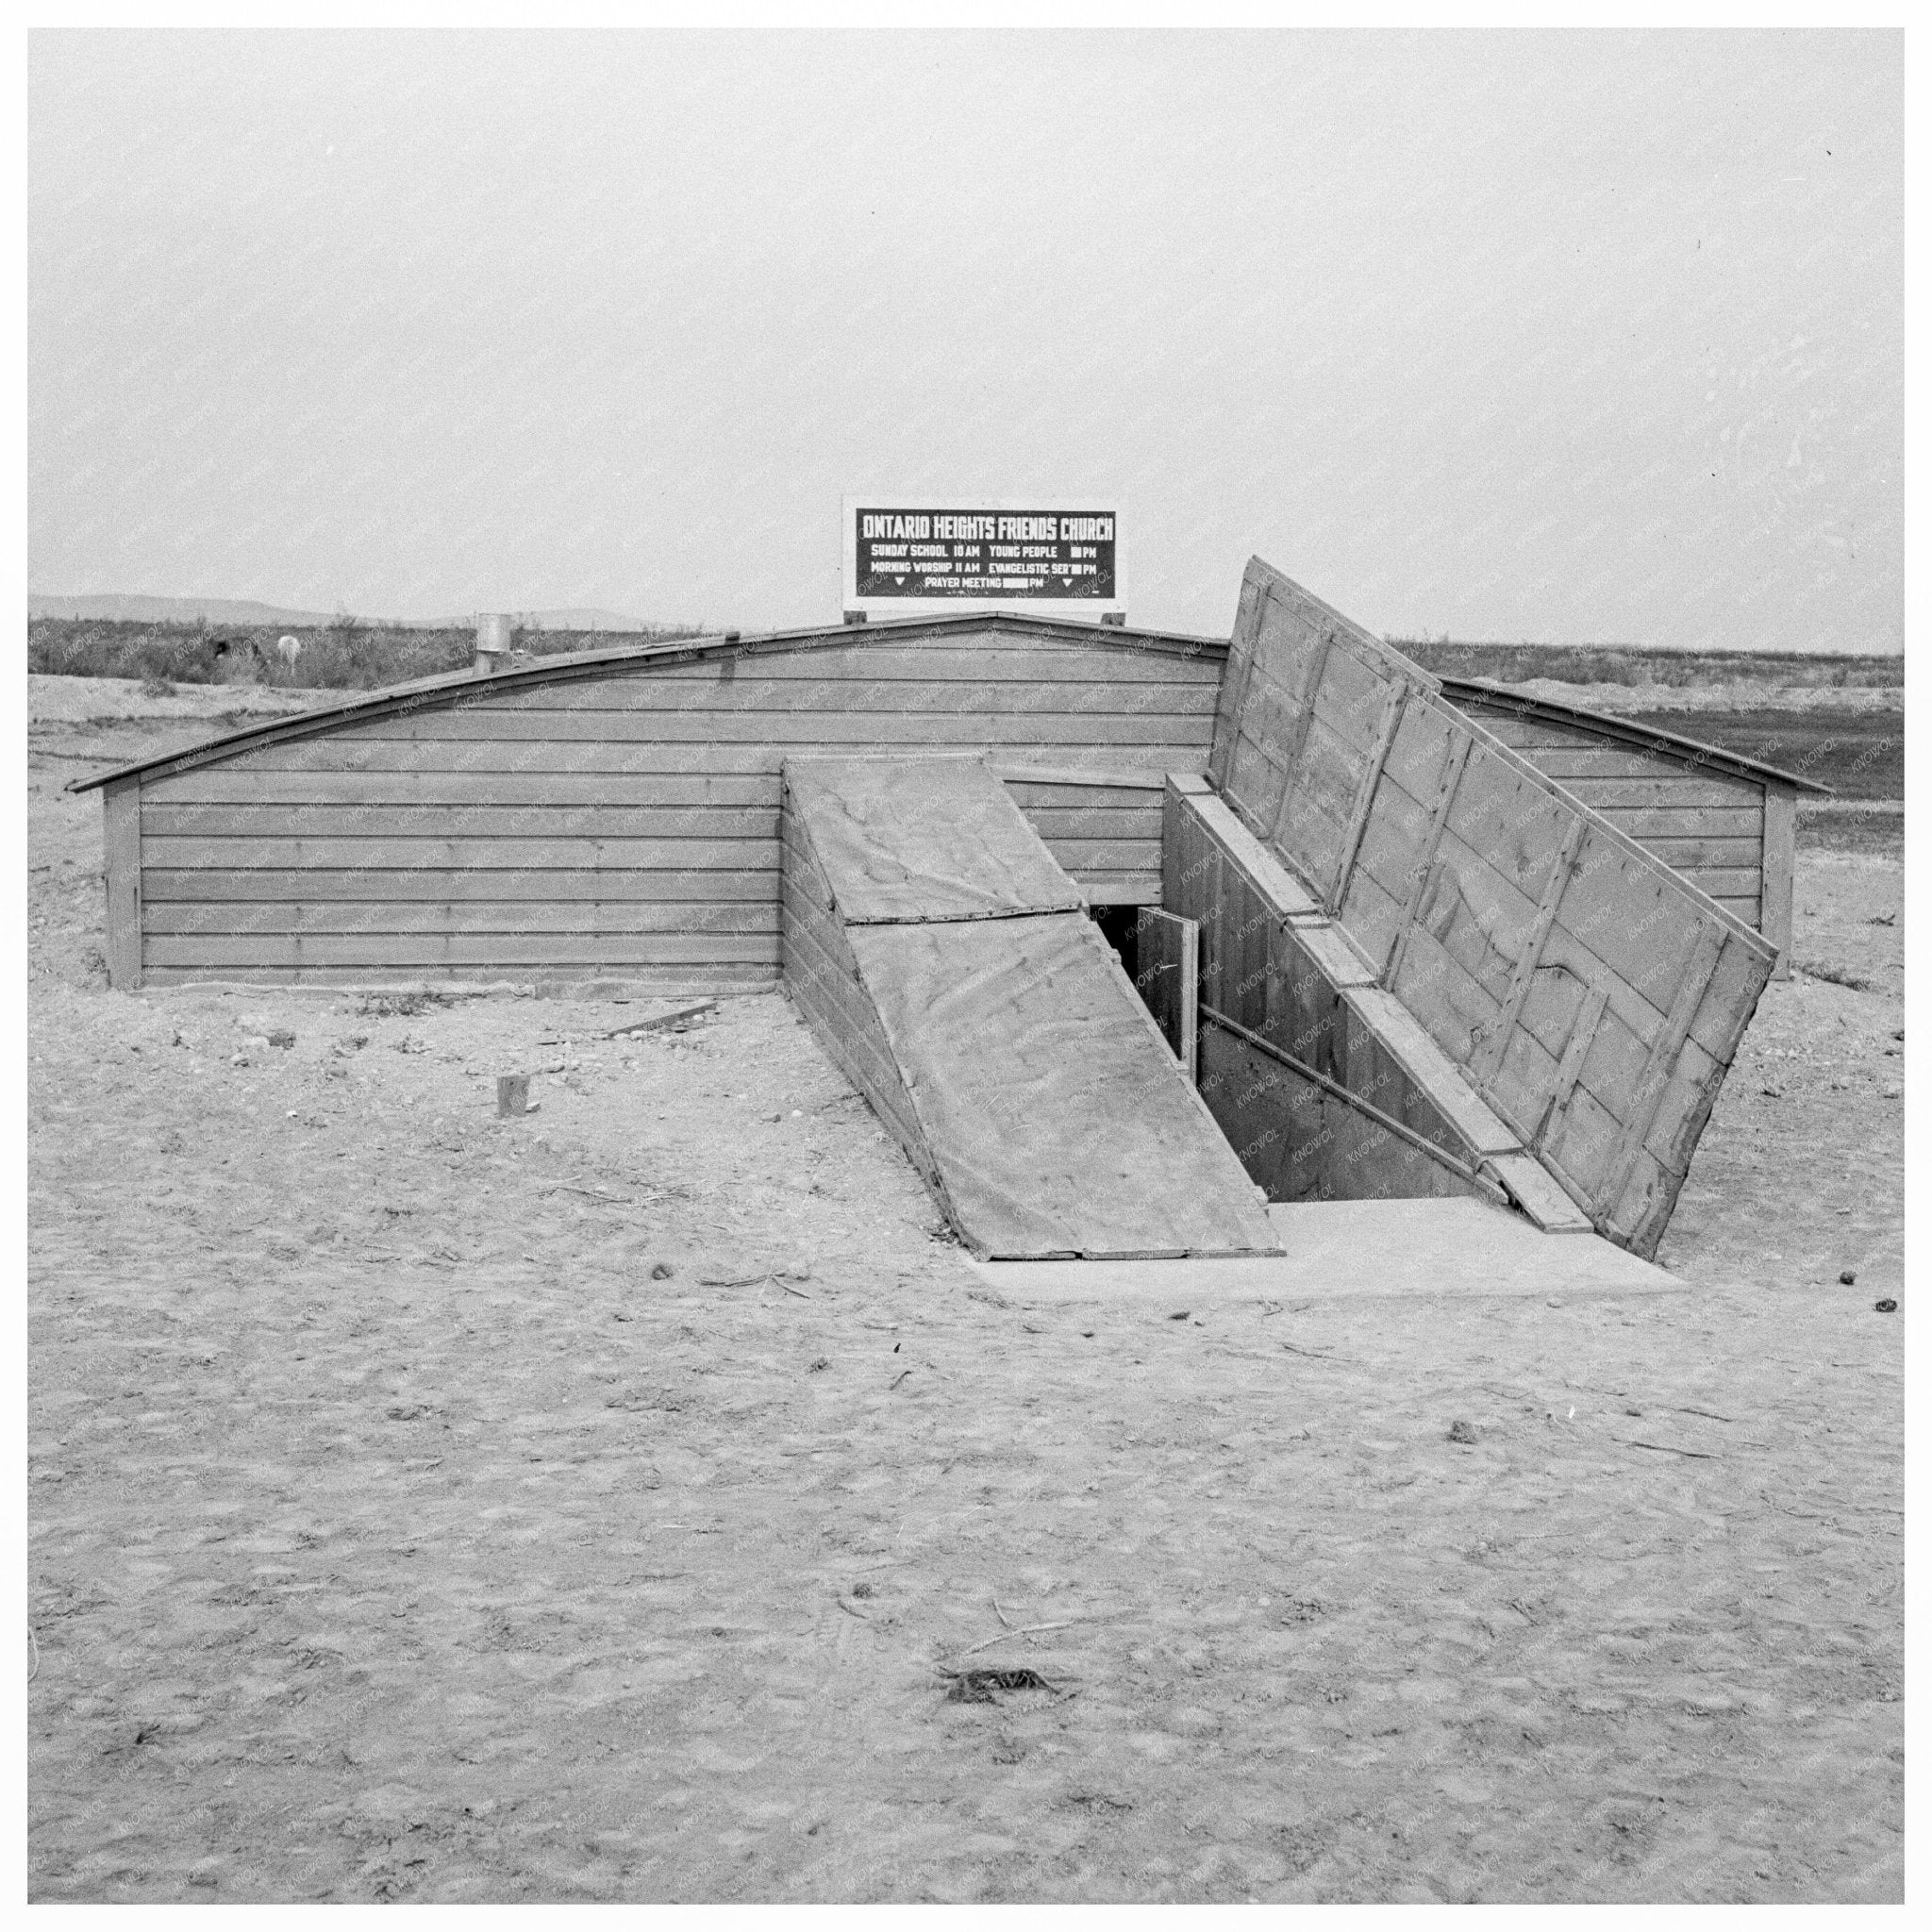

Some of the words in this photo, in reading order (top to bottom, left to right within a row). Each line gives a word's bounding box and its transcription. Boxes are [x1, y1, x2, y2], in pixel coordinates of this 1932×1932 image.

[863, 515, 930, 539] ONTARIO
[933, 515, 995, 540] HEIGHTS
[997, 517, 1058, 541] FRIENDS
[1060, 517, 1114, 541] CHURCH
[871, 543, 908, 557] SUNDAY
[910, 544, 948, 558] SCHOOL
[965, 545, 980, 558] AM
[989, 544, 1021, 558] YOUNG
[1022, 546, 1058, 558] PEOPLE
[1083, 546, 1097, 558] PM
[871, 561, 912, 573] MORNING
[912, 562, 952, 574] WORSHIP
[964, 563, 980, 574] AM
[988, 562, 1049, 575] EVANGELISTIC
[1083, 564, 1097, 575] PM
[924, 576, 960, 588] PRAYER
[961, 576, 1002, 589] MEETING
[1029, 577, 1044, 588] PM
